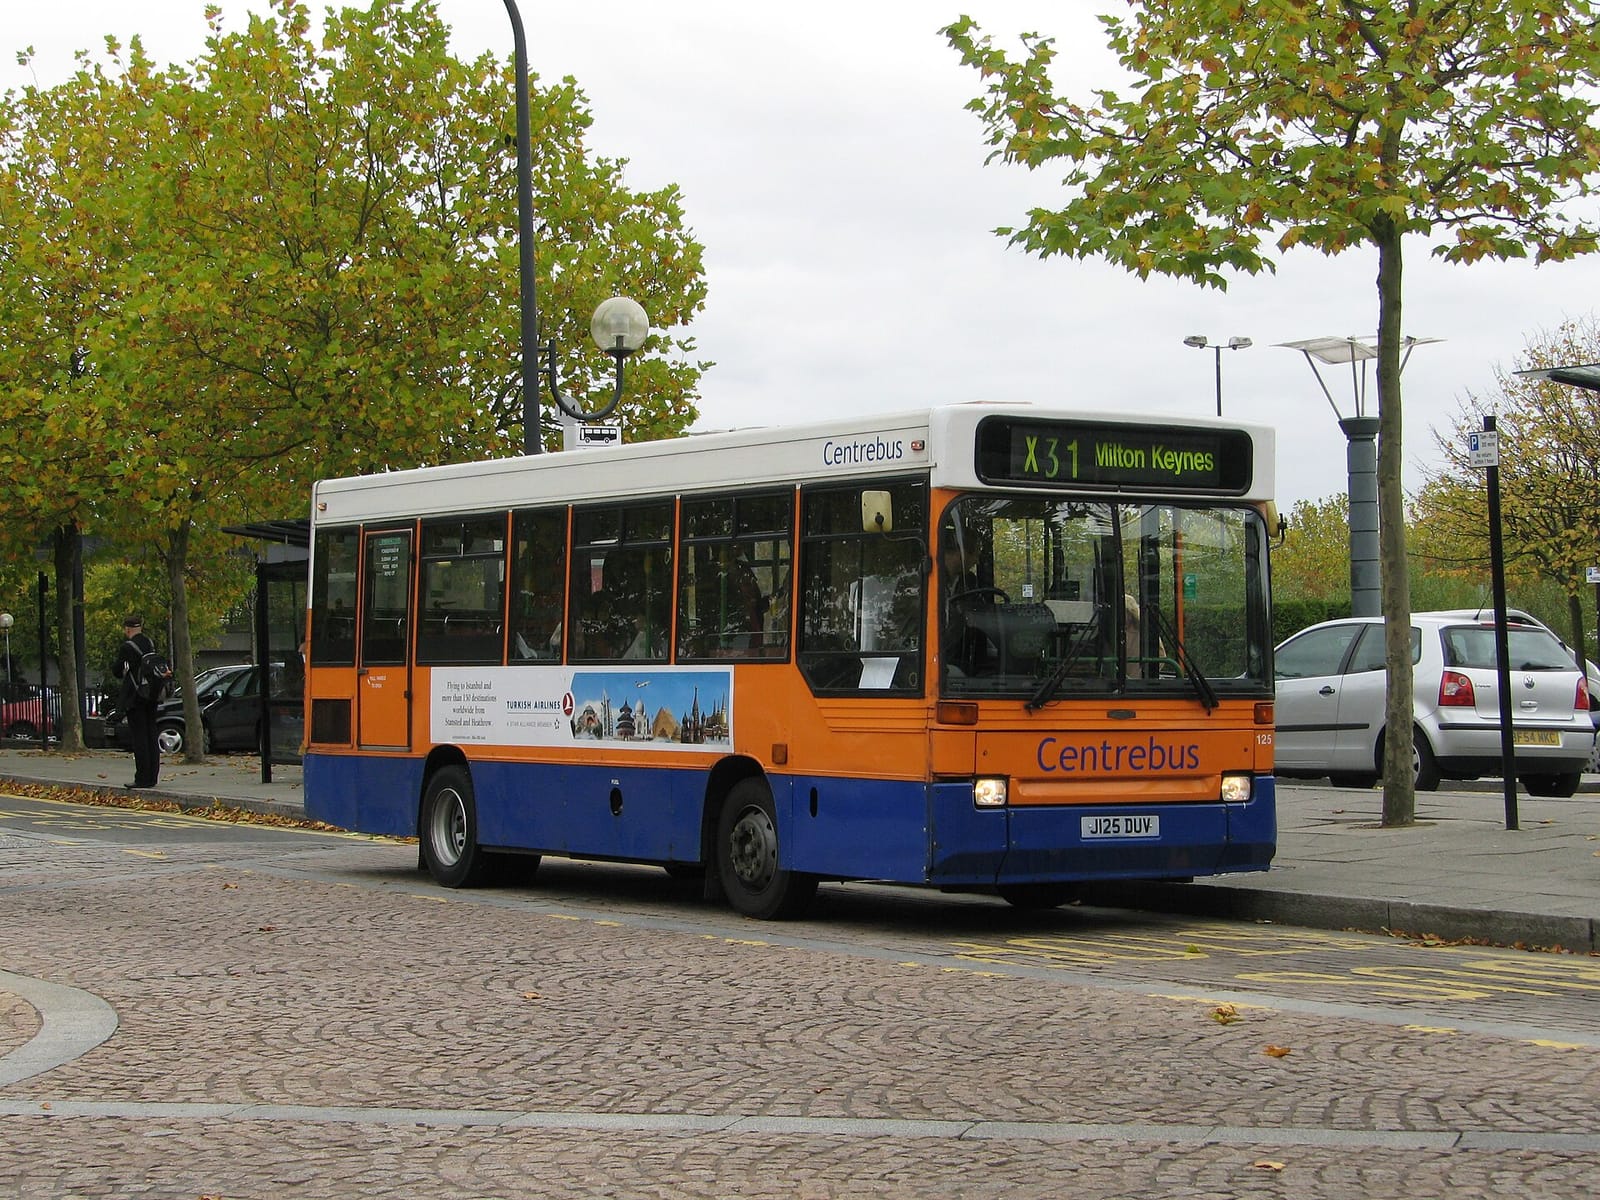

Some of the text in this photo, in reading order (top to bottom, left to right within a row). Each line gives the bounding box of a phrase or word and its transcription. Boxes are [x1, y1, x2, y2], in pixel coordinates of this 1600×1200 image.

[1471, 436, 1477, 450] P
[823, 436, 903, 465] Centrebus
[1095, 441, 1145, 469] Milton
[1151, 444, 1214, 475] Keynes
[446, 681, 460, 692] Flying
[484, 680, 492, 690] and
[453, 694, 462, 702] than
[475, 706, 485, 714] from
[507, 701, 561, 710] TURKISH AIRLINES
[463, 717, 471, 726] and
[1256, 734, 1272, 745] 125
[1037, 736, 1200, 772] Centrebus
[1090, 818, 1151, 834] J125 DUV
